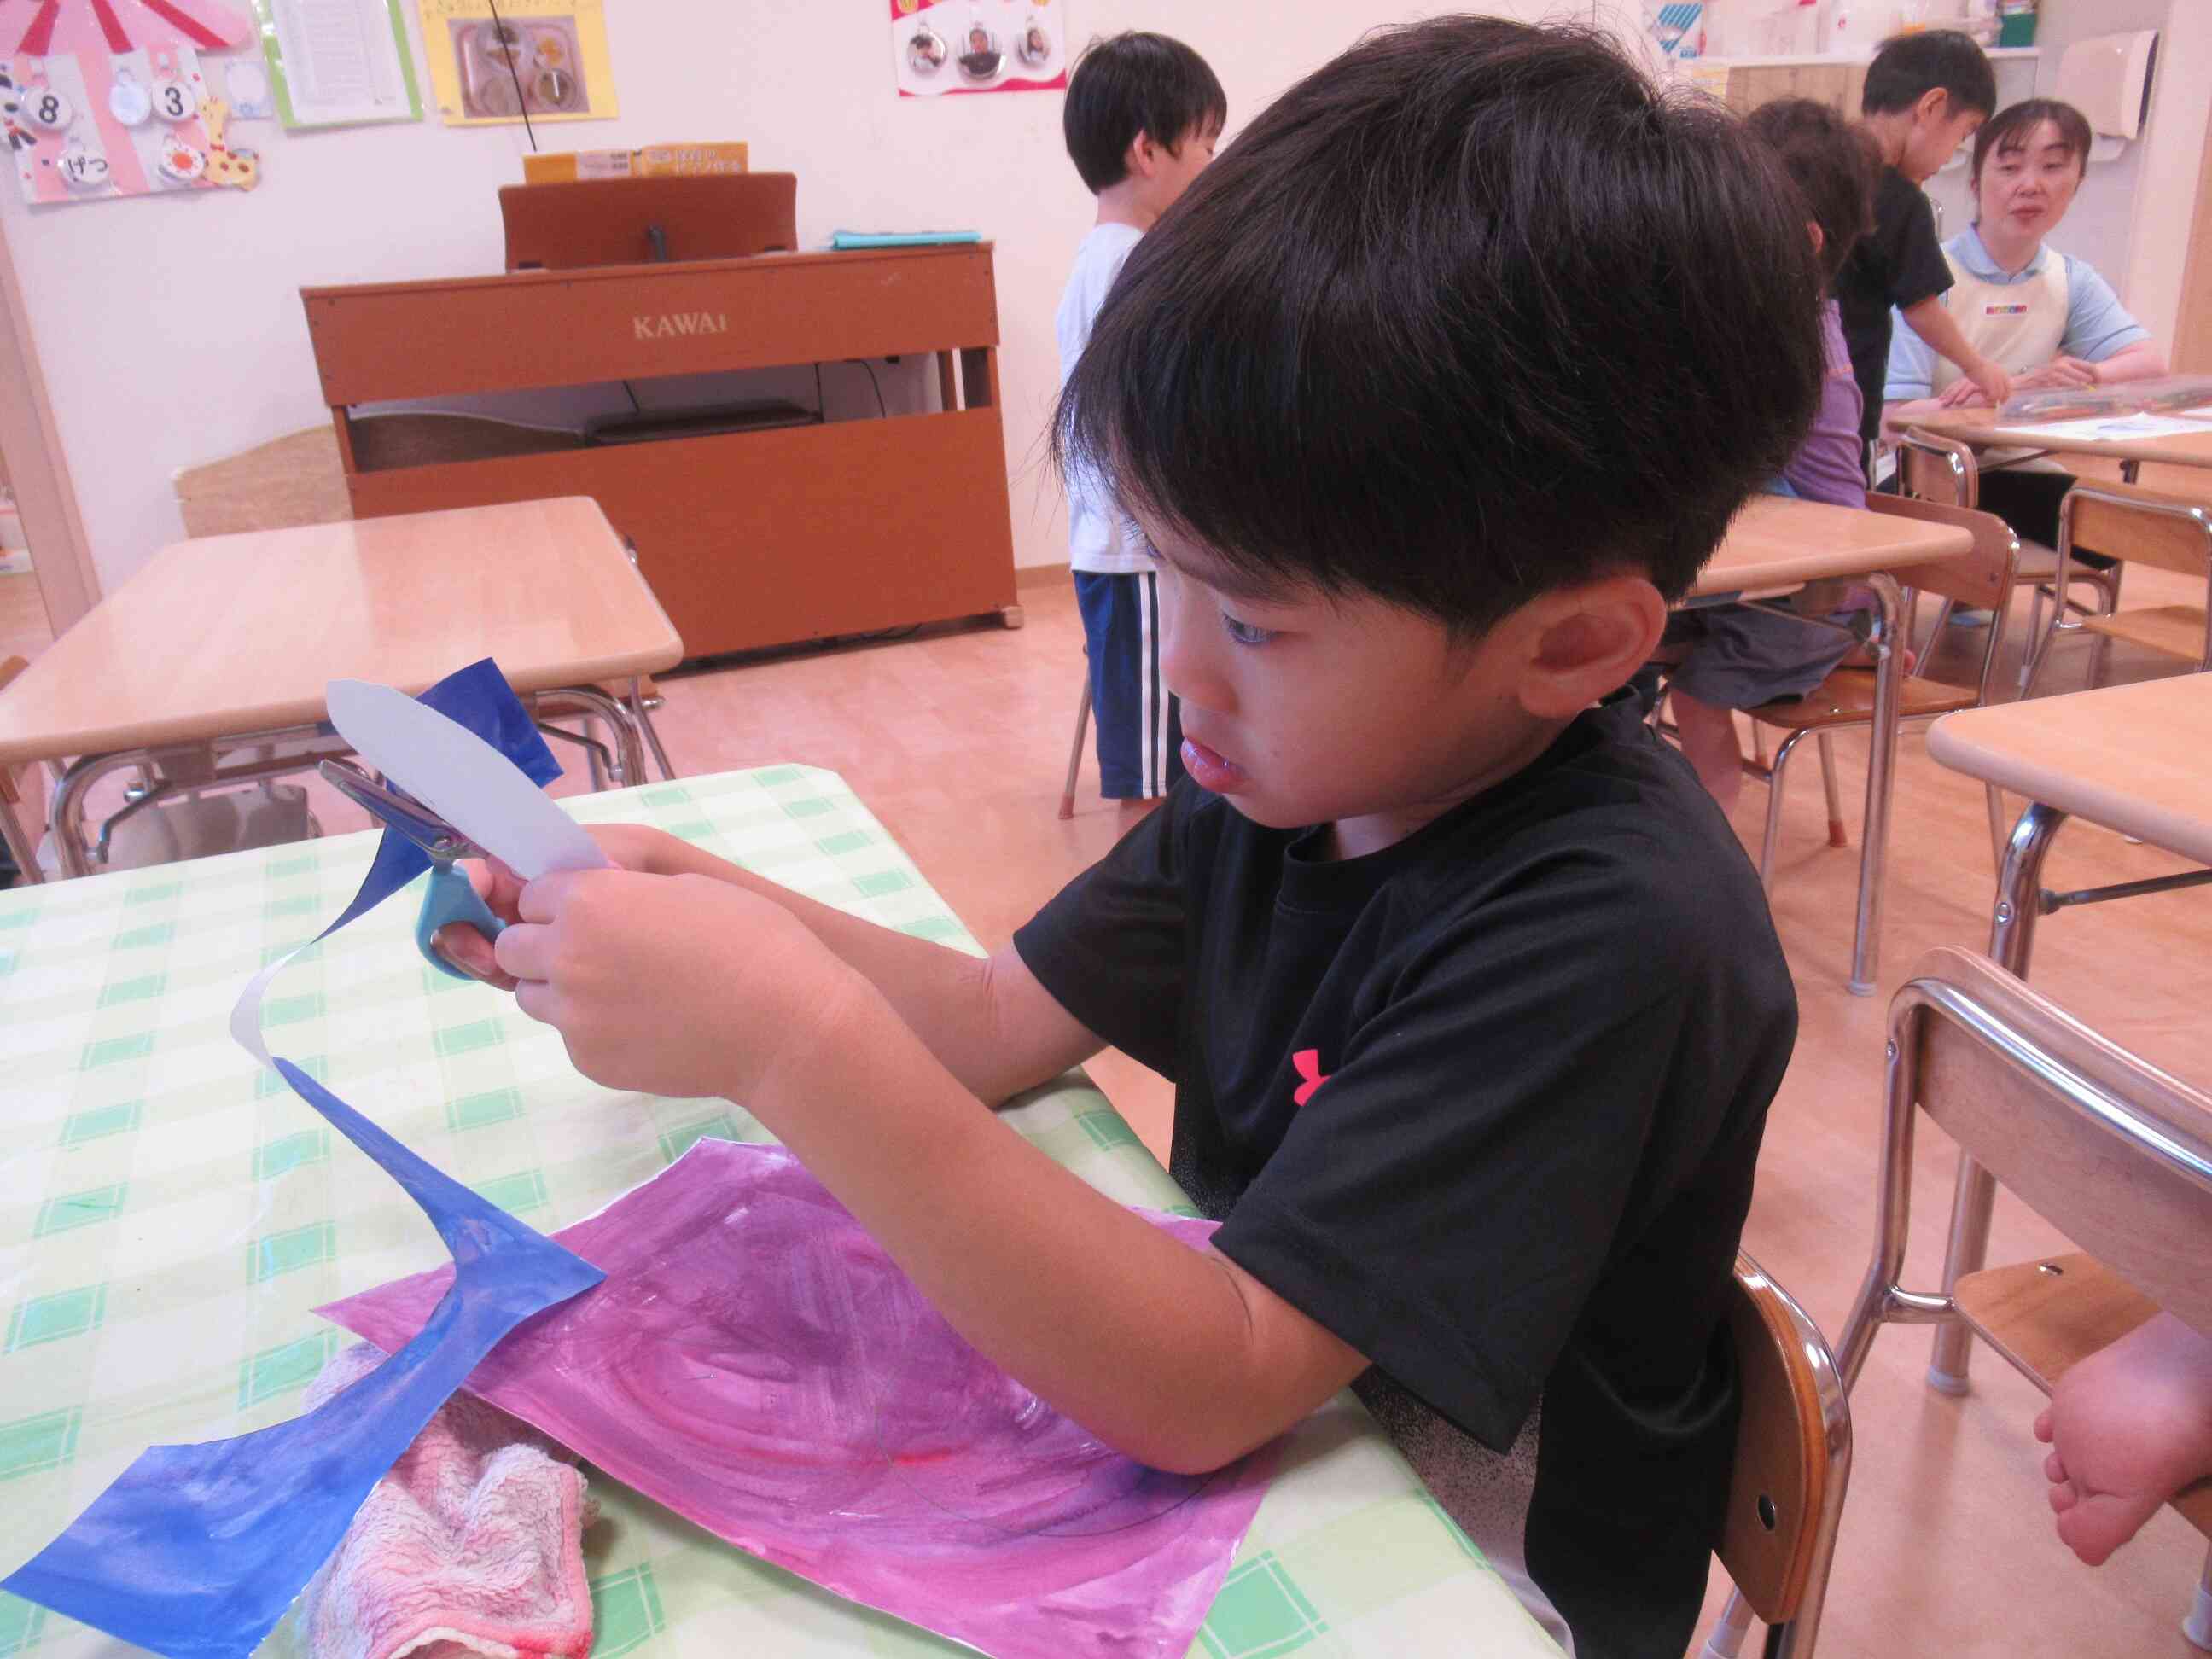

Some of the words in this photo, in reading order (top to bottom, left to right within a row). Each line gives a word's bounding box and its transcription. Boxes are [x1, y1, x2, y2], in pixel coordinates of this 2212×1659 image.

[38, 95, 59, 124] 8
[164, 86, 183, 116] 3
[633, 312, 728, 339] KAWAI
